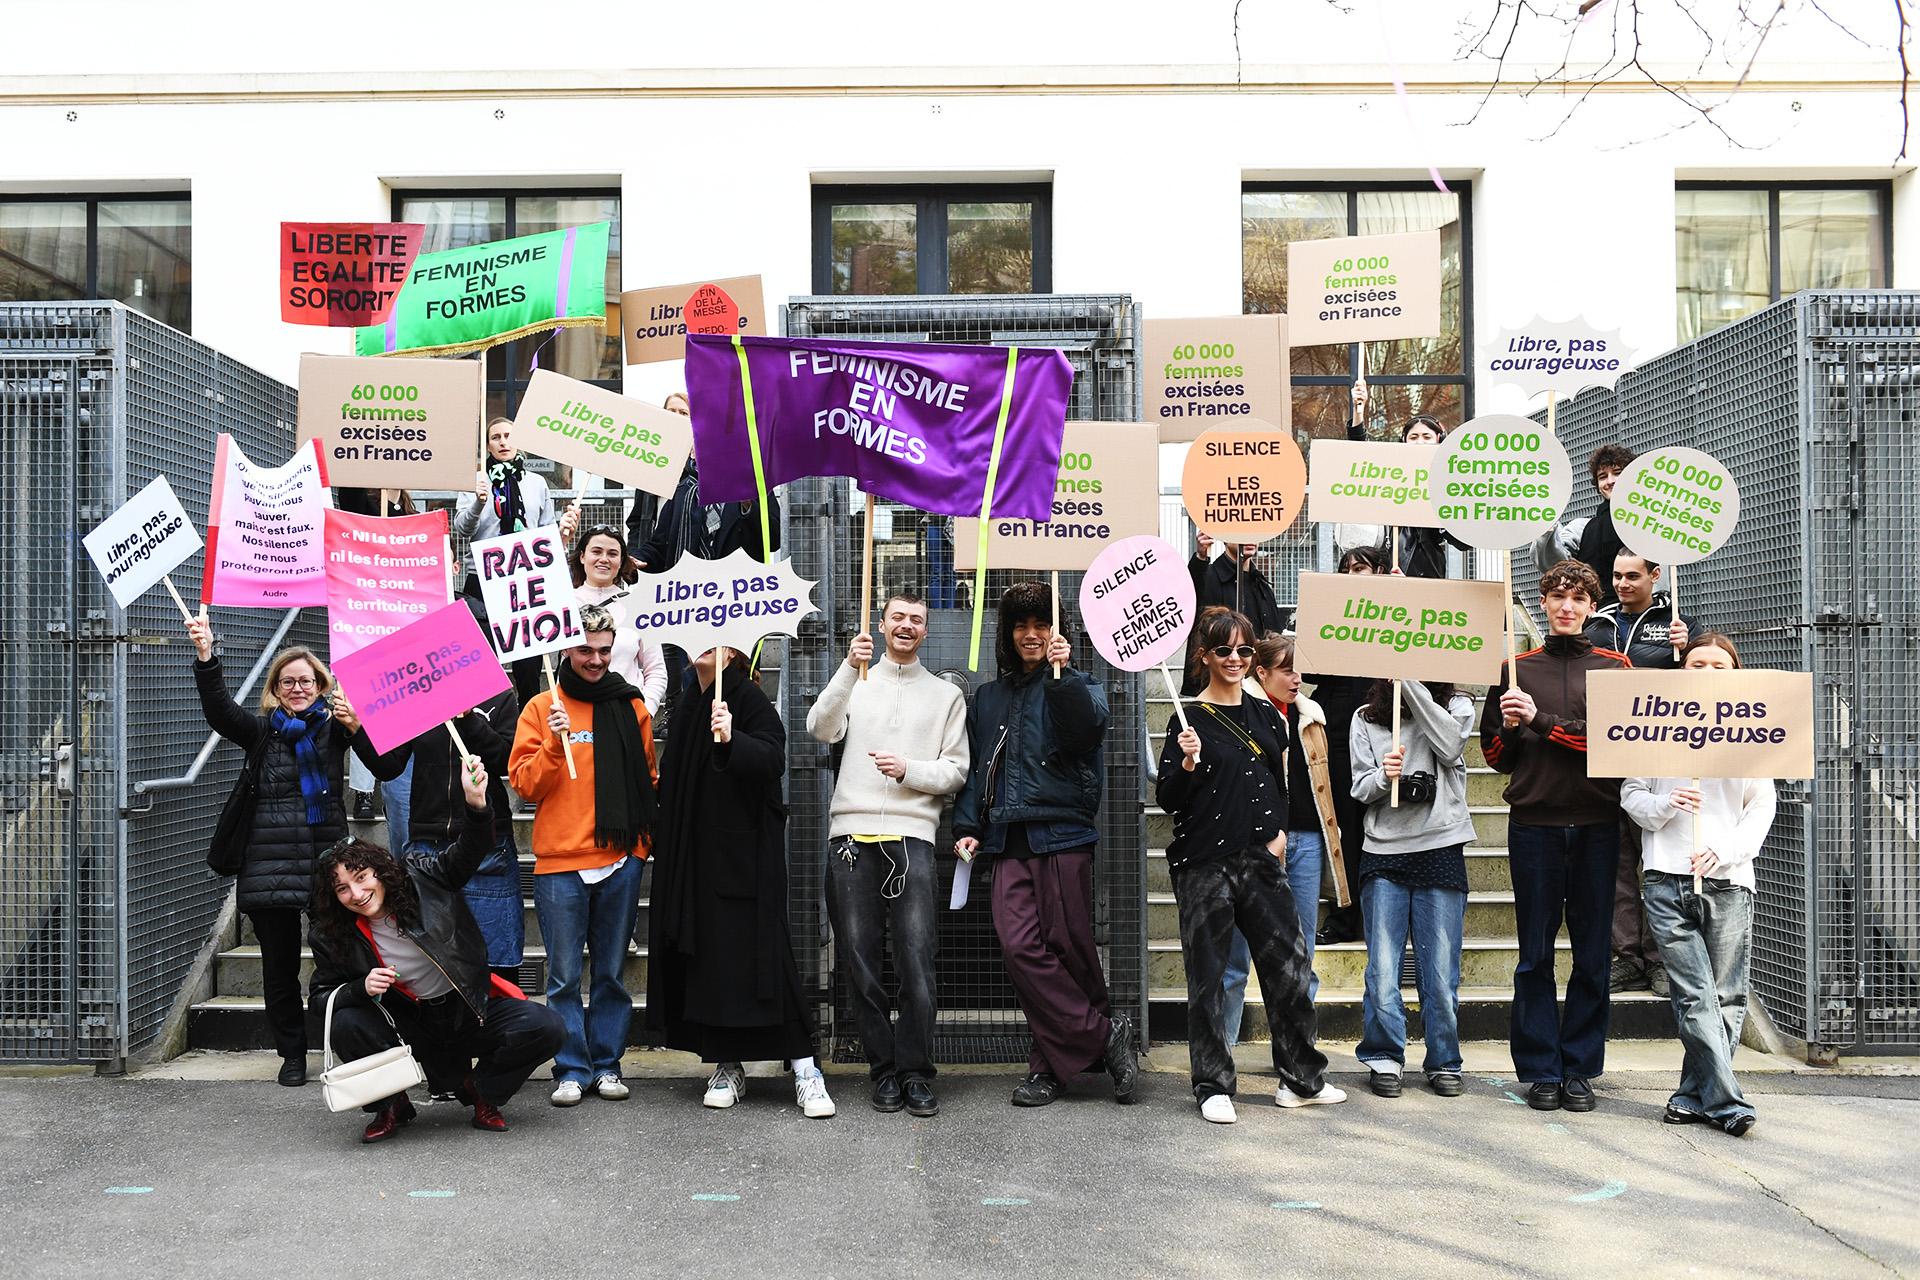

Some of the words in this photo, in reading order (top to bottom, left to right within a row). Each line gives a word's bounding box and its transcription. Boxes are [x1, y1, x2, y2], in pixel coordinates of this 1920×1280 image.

[291, 232, 408, 256] LIBERTE
[293, 260, 406, 283] EGALITE
[413, 245, 547, 284] FEMINISME
[1333, 259, 1353, 272] 60
[1357, 256, 1389, 271] 000
[465, 272, 497, 294] EN
[1324, 274, 1397, 289] femmes
[289, 287, 395, 311] SORORIT
[426, 285, 526, 320] FORMES
[695, 299, 709, 308] DE
[710, 297, 724, 306] LA
[699, 288, 716, 298] FIN
[1324, 289, 1397, 304] excisées
[650, 304, 683, 321] Libr
[693, 305, 728, 318] MESSE
[1319, 310, 1340, 321] en
[1344, 306, 1401, 319] France
[1172, 345, 1195, 360] 60
[1199, 344, 1235, 359] 000
[1508, 336, 1561, 354] Libre,
[1568, 339, 1607, 356] pas
[1164, 363, 1244, 379] femmes
[789, 350, 970, 413] FEMINISME
[1164, 381, 1245, 398] excisées
[351, 385, 375, 401] 60
[380, 385, 418, 401] 000
[848, 381, 897, 421] EN
[341, 403, 428, 422] femmes
[1160, 404, 1183, 417] en
[1188, 401, 1250, 417] France
[560, 400, 617, 434] Libre,
[620, 423, 662, 446] pas
[340, 425, 427, 441] excisées
[814, 407, 926, 465] FORMES
[1460, 433, 1489, 451] 60
[1494, 433, 1540, 452] 000
[334, 446, 359, 460] en
[364, 445, 433, 462] France
[1205, 441, 1280, 456] SILENCE
[1349, 461, 1408, 483] Libre,
[1447, 455, 1551, 475] femmes
[1653, 456, 1680, 475] 60
[1682, 465, 1723, 491] 000
[1227, 476, 1260, 491] LES
[1446, 478, 1550, 499] excisées
[1635, 469, 1722, 514] femmes
[1206, 492, 1282, 507] FEMMES
[1204, 507, 1284, 522] HURLENT
[1438, 505, 1468, 521] en
[1474, 503, 1556, 521] France
[1627, 491, 1714, 533] excisées
[107, 533, 143, 564] Libre,
[142, 510, 167, 538] pas
[286, 523, 314, 535] faux.
[352, 529, 370, 542] Ni
[370, 533, 388, 545] la
[389, 532, 428, 545] terre
[998, 522, 1027, 537] en
[1032, 521, 1110, 539] France
[1613, 508, 1640, 526] en
[1642, 515, 1712, 554] France
[242, 534, 263, 546] Nos
[264, 537, 309, 549] silences
[254, 552, 269, 561] ne
[270, 554, 298, 563] nous
[330, 550, 346, 563] ni
[348, 551, 372, 566] les
[374, 553, 439, 567] femmes
[482, 536, 555, 581] RAS
[295, 566, 319, 575] pas.
[1093, 549, 1157, 599] SILENCE
[356, 576, 377, 589] ne
[379, 577, 415, 590] sont
[655, 580, 724, 603] Libre,
[732, 575, 779, 601] pas
[262, 590, 288, 598] Audre
[509, 575, 546, 613] LE
[347, 597, 428, 614] territoires
[1123, 593, 1153, 621] LES
[1343, 598, 1413, 626] Libre,
[1420, 608, 1468, 630] pas
[332, 619, 353, 634] de
[492, 606, 581, 654] VIOL
[1112, 596, 1178, 647] FEMMES
[1117, 609, 1185, 662] HURLENT
[370, 661, 424, 694] Libre,
[425, 640, 462, 669] pas
[1631, 694, 1707, 721] Libre,
[1716, 701, 1767, 725] pas
